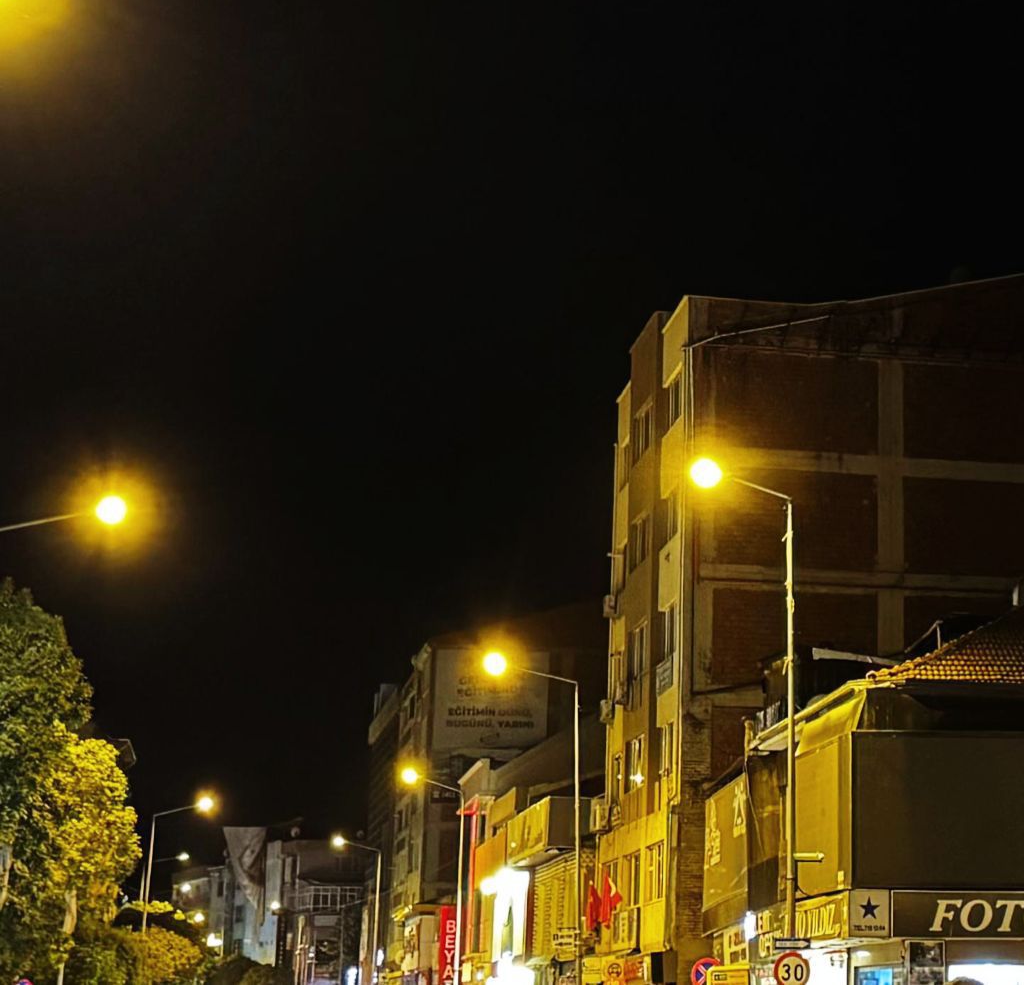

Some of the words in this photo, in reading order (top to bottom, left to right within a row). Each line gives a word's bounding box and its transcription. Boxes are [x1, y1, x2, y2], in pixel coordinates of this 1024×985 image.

[807, 903, 837, 938] YILDIZ
[442, 919, 456, 985] BEYA
[781, 963, 804, 982] 30
